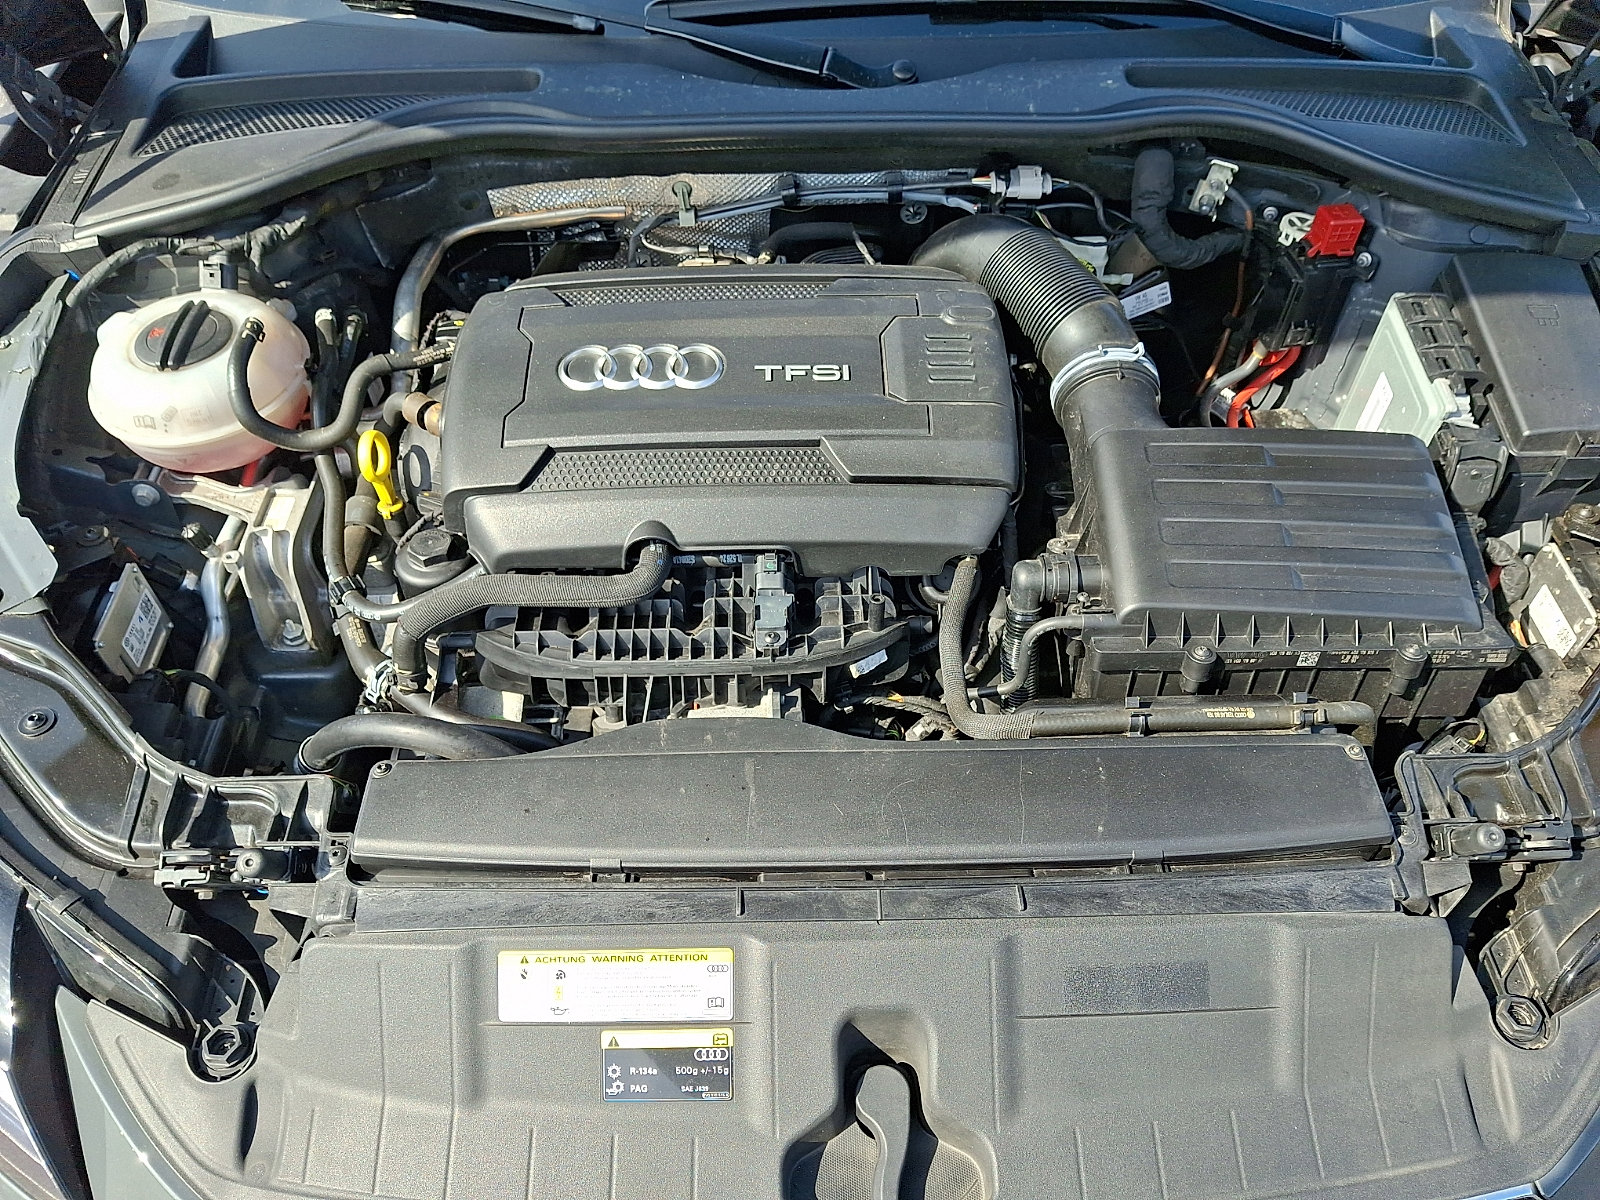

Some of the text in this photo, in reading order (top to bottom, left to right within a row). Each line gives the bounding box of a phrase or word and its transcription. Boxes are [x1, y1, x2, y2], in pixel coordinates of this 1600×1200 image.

[754, 364, 851, 382] TFSI
[534, 953, 708, 964] ACHTUNG WARNING ATTENTION
[629, 1066, 658, 1076] R-134a
[675, 1066, 698, 1076] 500g
[629, 1084, 648, 1093] PAG
